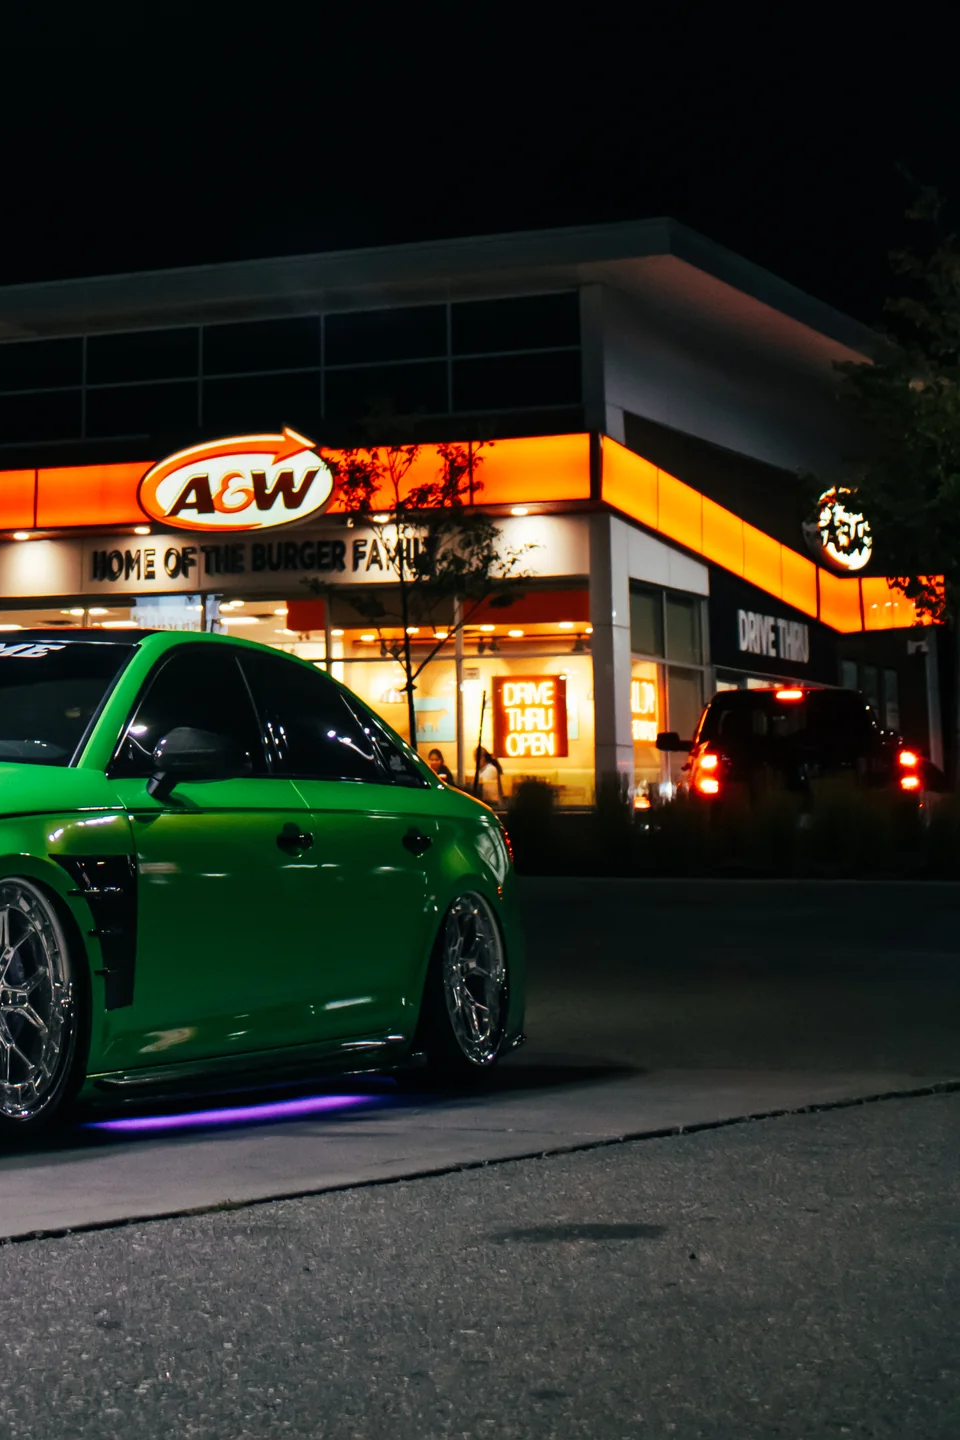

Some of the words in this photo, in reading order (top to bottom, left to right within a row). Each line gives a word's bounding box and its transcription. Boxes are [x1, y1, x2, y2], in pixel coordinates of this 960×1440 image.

[163, 468, 321, 517] A&W
[92, 547, 157, 582] HOME
[163, 546, 197, 580] OF
[201, 543, 245, 576] THE
[251, 539, 347, 572] BURGER
[738, 609, 777, 657] DRIVE
[777, 618, 810, 664] THRU
[503, 681, 554, 706] DRIVE
[505, 707, 553, 731] THRU
[506, 732, 555, 757] OPEN
